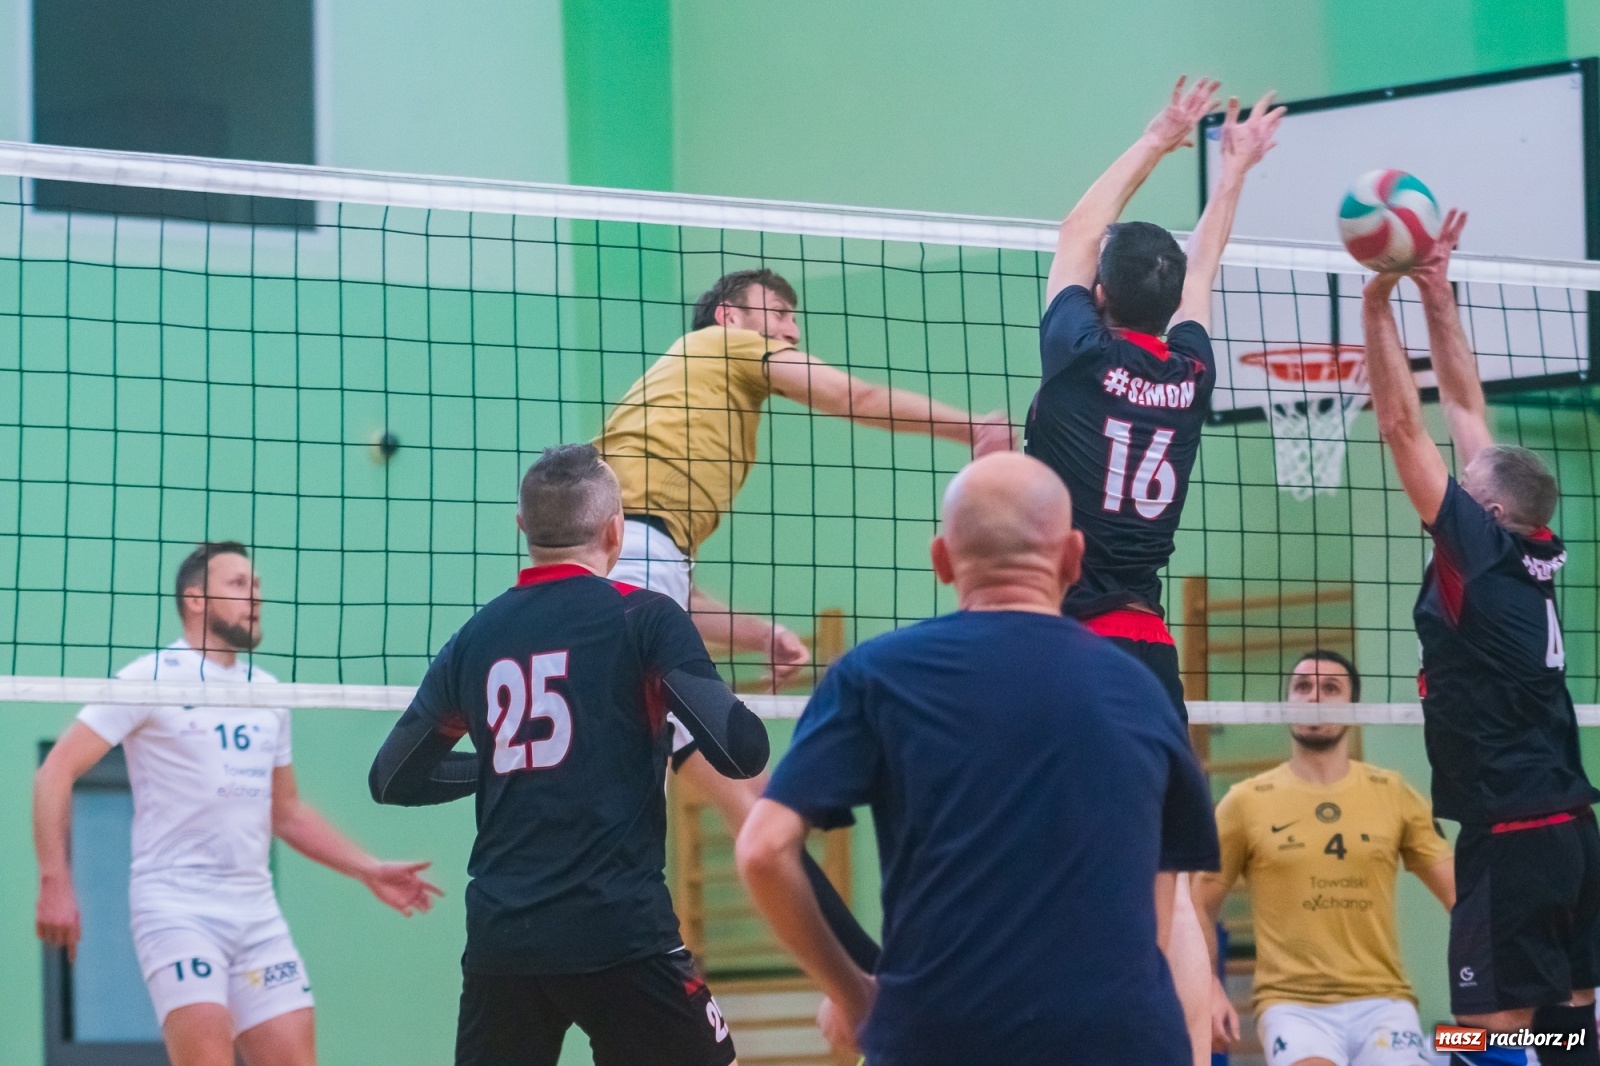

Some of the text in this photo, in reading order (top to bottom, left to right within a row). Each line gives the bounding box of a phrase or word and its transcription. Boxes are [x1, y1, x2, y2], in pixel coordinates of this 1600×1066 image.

[1103, 367, 1196, 408] #SIMON
[1103, 416, 1177, 520] 16
[1545, 599, 1565, 671] 4
[485, 650, 572, 774] 25
[214, 723, 251, 751] 16
[1324, 833, 1348, 860] 4
[173, 957, 212, 981] 16
[705, 995, 729, 1043] 2
